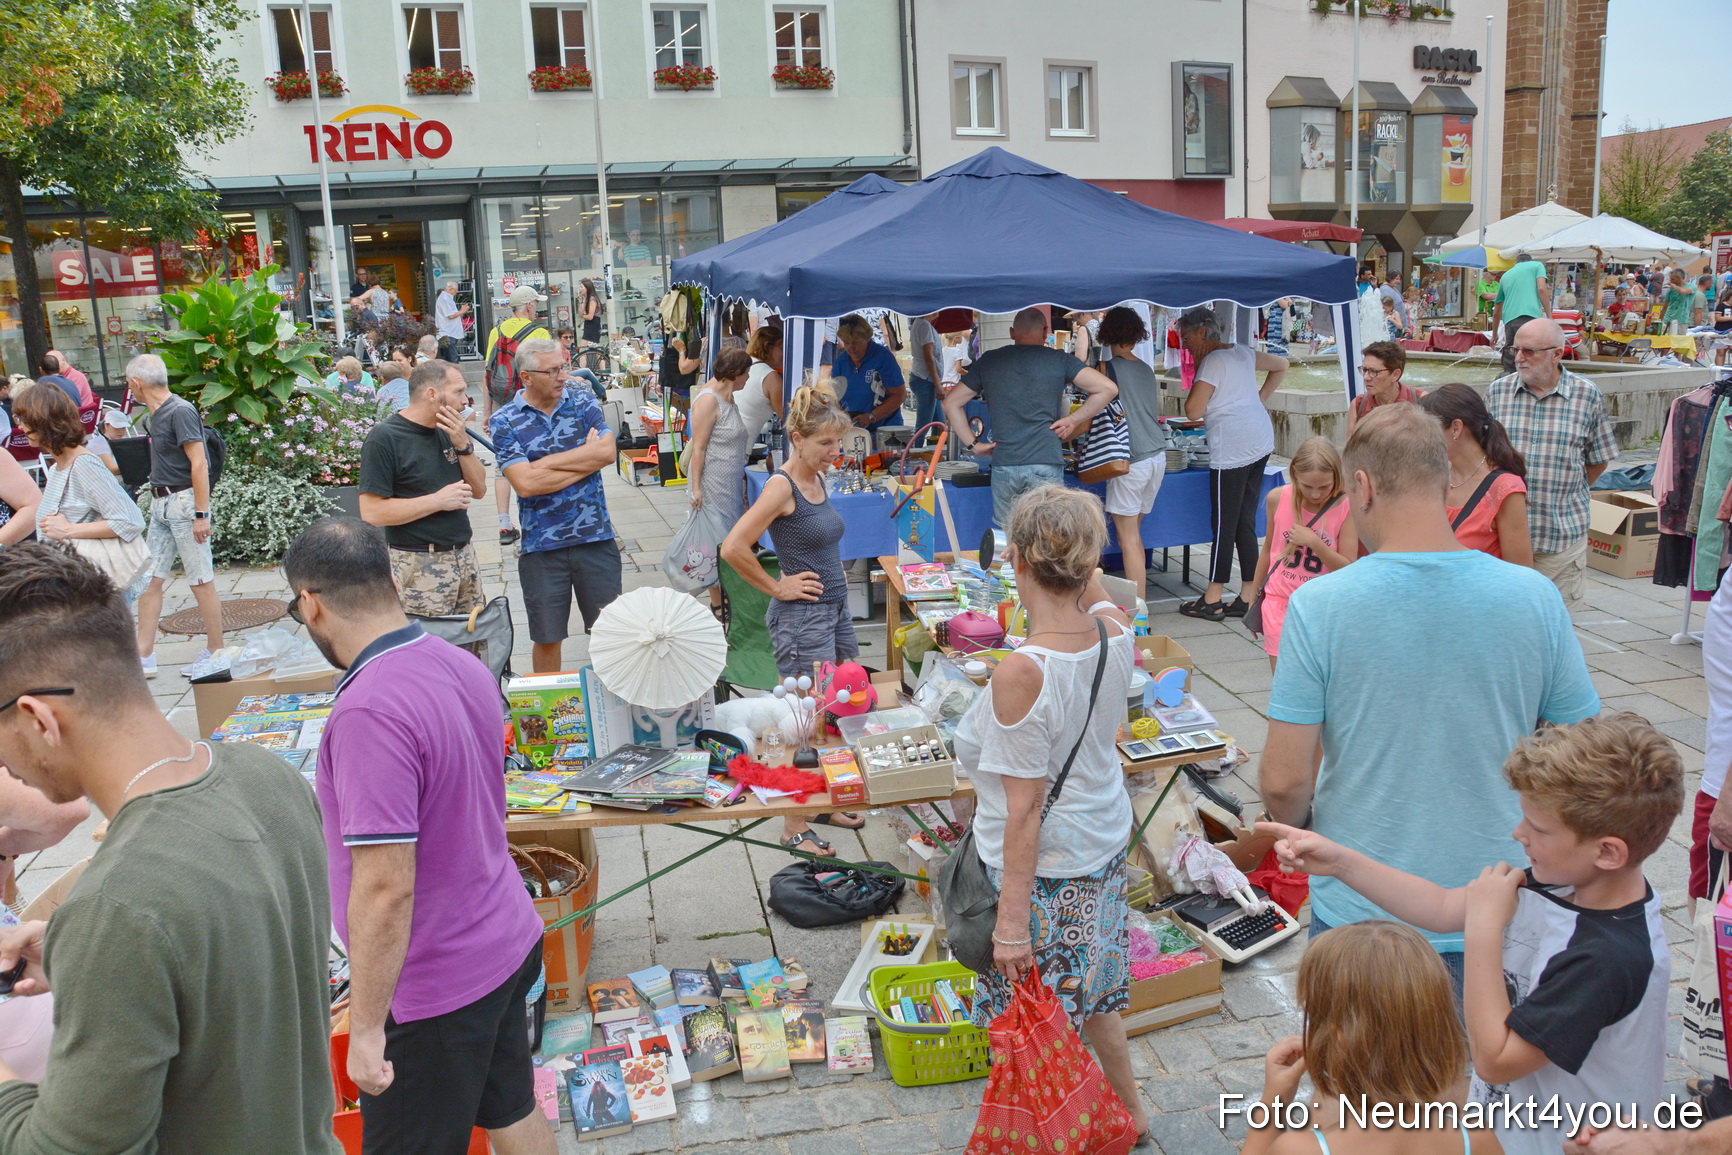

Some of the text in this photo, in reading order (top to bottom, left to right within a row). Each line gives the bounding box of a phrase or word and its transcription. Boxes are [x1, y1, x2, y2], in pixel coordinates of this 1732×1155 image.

[1413, 45, 1482, 73] RACKL
[1421, 72, 1472, 86] am Rathaus
[1376, 124, 1398, 139] RACKL
[303, 119, 453, 164] RENO
[59, 254, 157, 287] SALE
[1281, 570, 1297, 580] NEW
[235, 715, 284, 723] Elektro
[546, 988, 570, 1000] BI
[573, 1071, 618, 1087] SWAN
[589, 1067, 612, 1077] DARK
